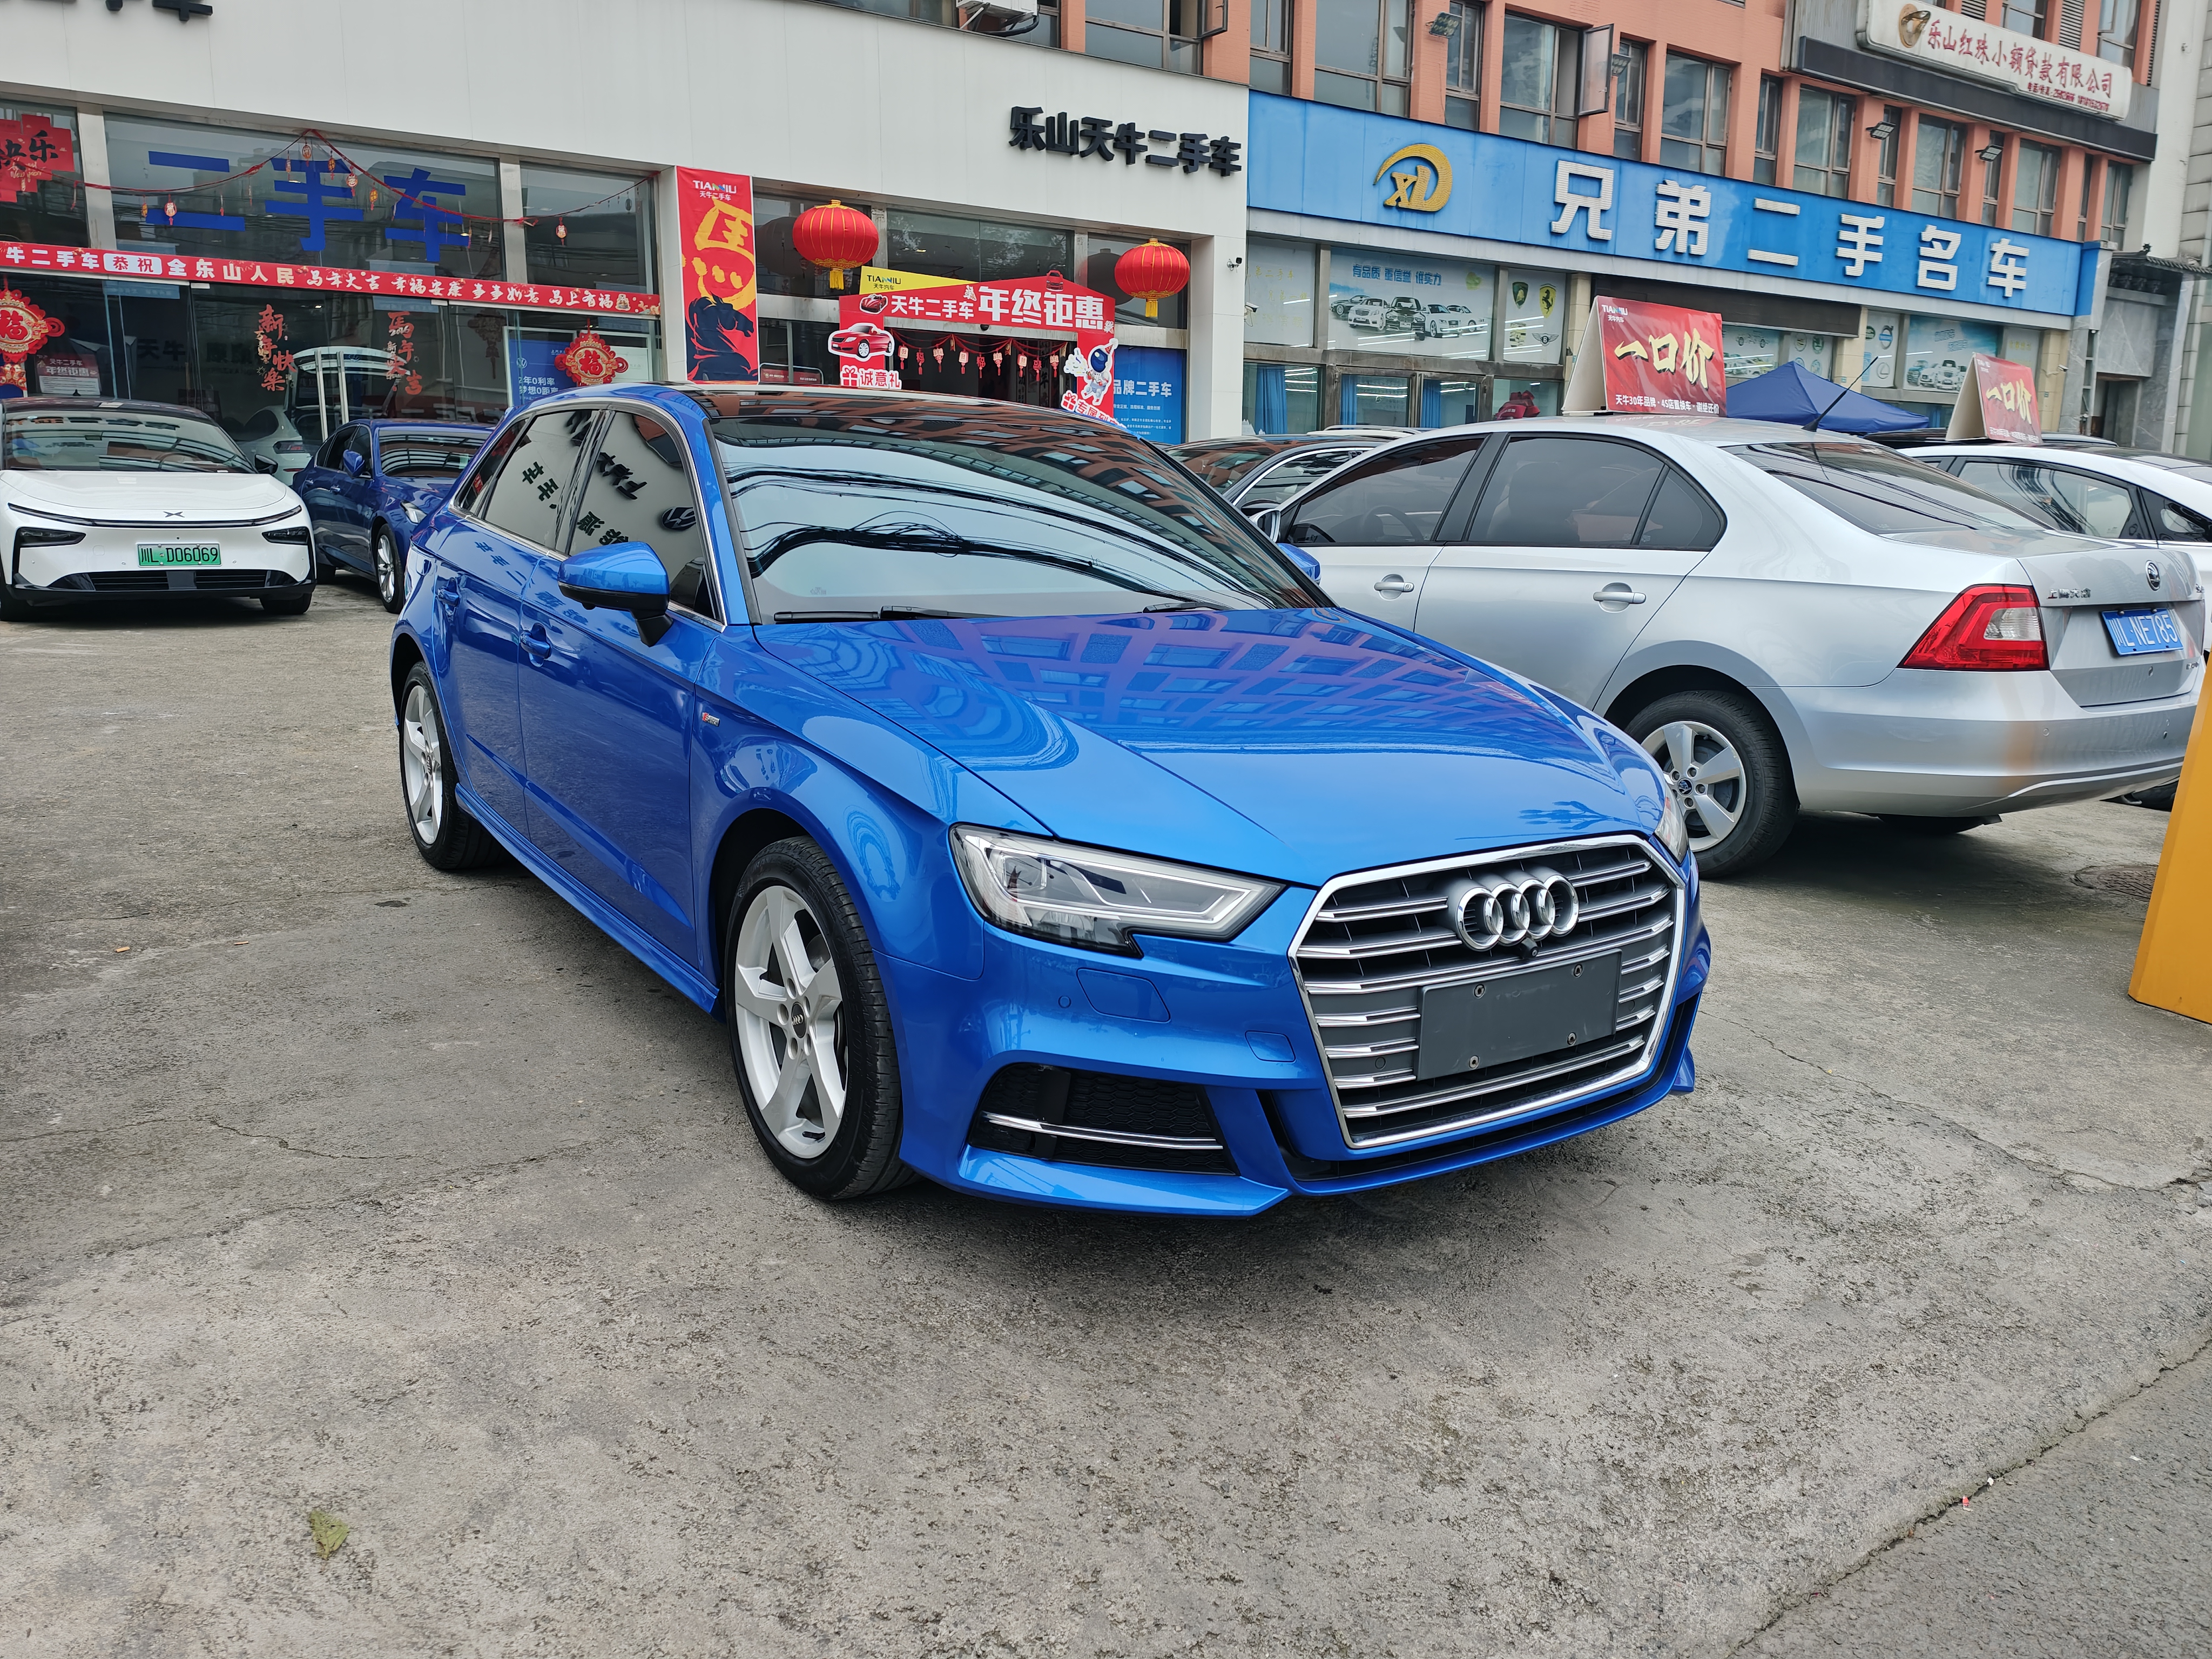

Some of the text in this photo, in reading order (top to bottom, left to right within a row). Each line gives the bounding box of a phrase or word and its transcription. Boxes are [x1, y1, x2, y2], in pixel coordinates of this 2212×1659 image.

[1009, 106, 1242, 177] 乐山天牛二手车
[145, 151, 470, 262] 二手车
[699, 191, 731, 201] 天牛二手车
[1550, 159, 2030, 298] 兄弟二手名车
[5, 246, 99, 269] 牛二手车
[112, 256, 154, 273] 恭祝
[167, 258, 294, 285] 全乐山人民
[307, 269, 381, 291] 马年大吉
[391, 275, 463, 297] 幸福安康
[549, 289, 614, 309] 马上有福
[891, 286, 1104, 330] 天牛二手车 年终钜惠
[860, 370, 900, 388] 诚意礼
[1614, 328, 1715, 390] 一口价
[1114, 379, 1172, 397] 品牌二手车
[1986, 379, 2032, 425] 一口价
[1077, 400, 1118, 425] 专属到
